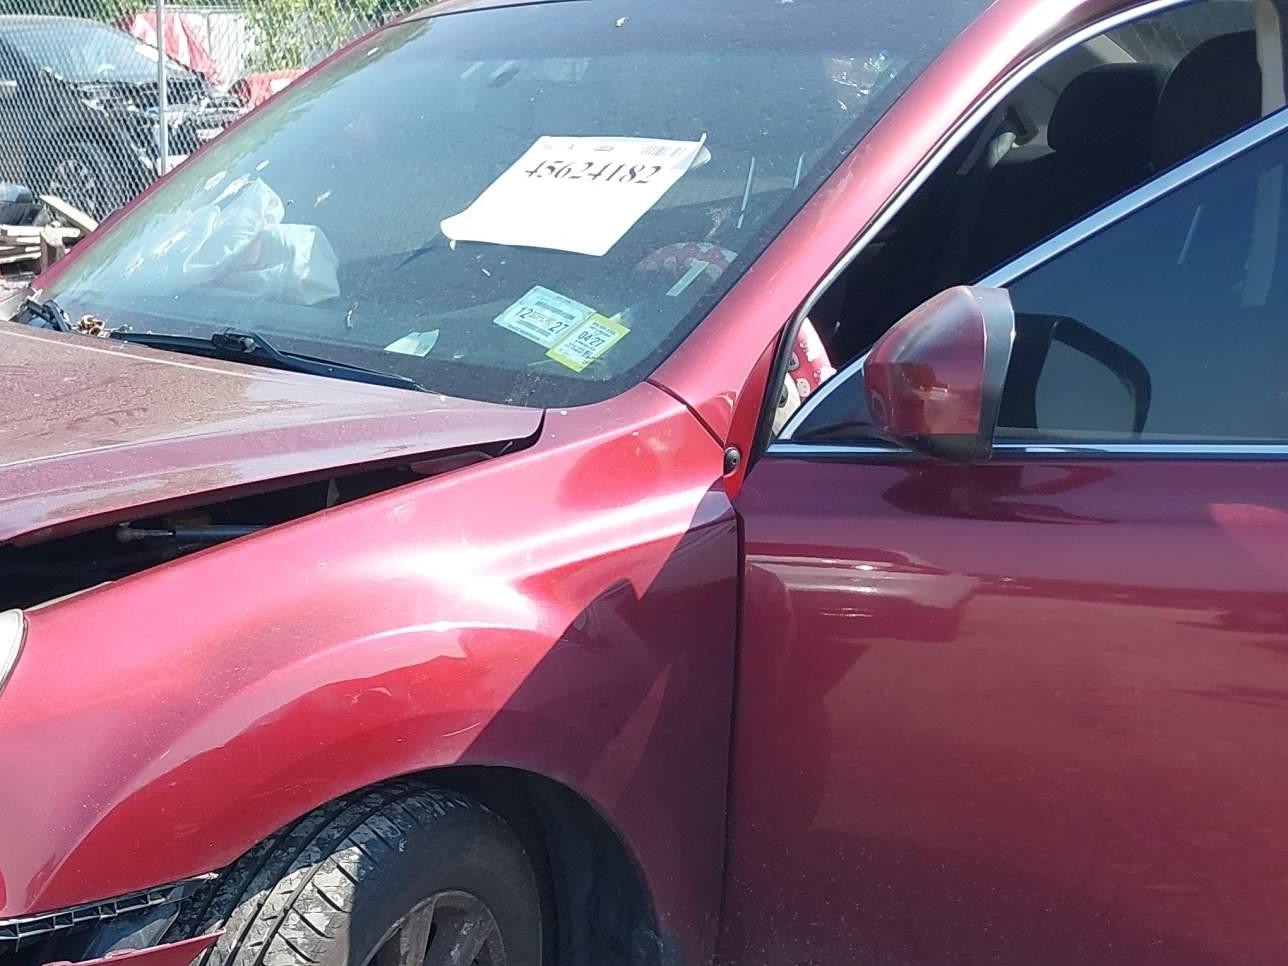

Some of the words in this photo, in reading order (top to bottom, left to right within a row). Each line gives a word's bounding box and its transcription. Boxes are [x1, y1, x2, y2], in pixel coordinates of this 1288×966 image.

[525, 160, 662, 184] 45624182
[515, 306, 534, 319] 12
[548, 321, 570, 334] 27
